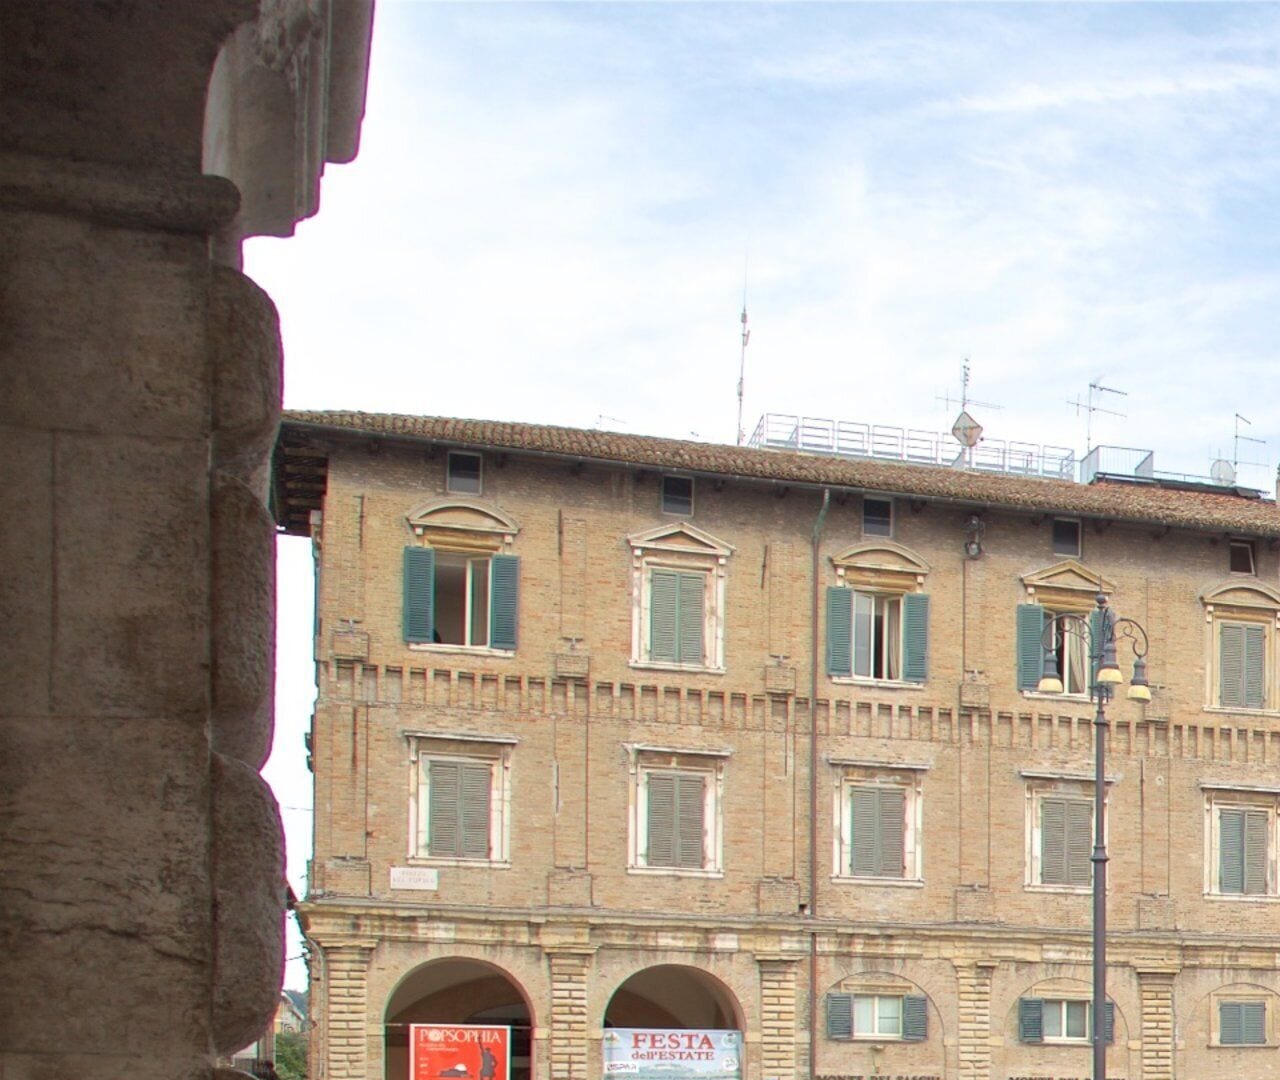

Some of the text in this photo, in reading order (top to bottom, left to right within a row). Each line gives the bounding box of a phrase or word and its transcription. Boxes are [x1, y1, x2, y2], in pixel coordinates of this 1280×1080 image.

[419, 1028, 502, 1043] POPSOPHIA
[632, 1032, 715, 1049] FESTA
[631, 1051, 715, 1061] dell'ESTATE
